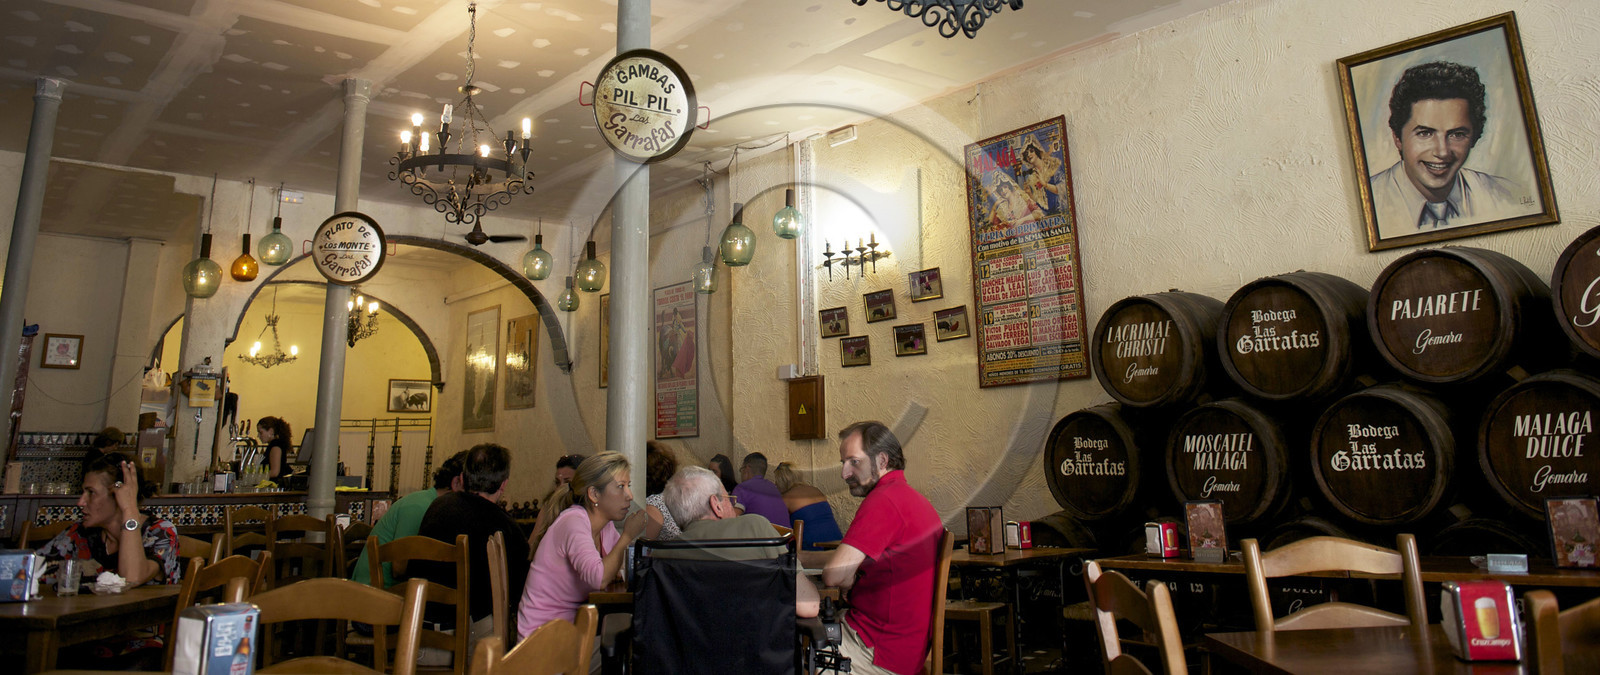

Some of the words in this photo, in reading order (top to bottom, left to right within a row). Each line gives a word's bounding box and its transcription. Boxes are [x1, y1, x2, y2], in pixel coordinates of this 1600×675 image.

[616, 63, 676, 94] GAMBAS
[613, 87, 638, 106] PIL
[647, 93, 672, 112] PIL
[629, 113, 651, 124] Las
[603, 112, 676, 152] Garrafas
[324, 221, 355, 240] PLATO
[358, 225, 371, 239] DE
[980, 230, 1004, 243] FERIA
[1005, 227, 1016, 238] de
[1017, 215, 1067, 235] PRIMAVERA
[338, 241, 371, 251] MONTE
[977, 243, 989, 252] Con
[989, 239, 1009, 250] motivo
[1010, 237, 1018, 246] de
[1018, 236, 1024, 244] la
[1024, 231, 1050, 242] SEMANA
[1050, 226, 1071, 236] SANTA
[978, 252, 986, 261] 4
[1003, 253, 1023, 262] CORRIDA
[1027, 257, 1036, 270] 13
[321, 253, 372, 277] Garrafas
[981, 264, 990, 279] 12
[1027, 270, 1041, 280] LUIS
[1044, 264, 1072, 277] DOMECQ
[981, 277, 1005, 289] SANCHEZ
[1041, 273, 1073, 285] CARTAGENA
[982, 285, 1005, 296] UCEDA
[1008, 281, 1025, 291] LEAL
[1029, 286, 1047, 296] DIEGO
[1048, 279, 1074, 292] VENTURA
[982, 293, 1001, 303] RAFAEL
[1001, 291, 1009, 300] DE
[1390, 288, 1484, 321] PAJARETE
[984, 312, 994, 325] 19
[1031, 305, 1041, 318] 20
[1051, 313, 1077, 325] ORTEGA
[1250, 309, 1297, 325] Bodega
[1003, 320, 1029, 331] PUERTO
[1039, 322, 1078, 334] MANZANARES
[1107, 320, 1173, 344] LACRIMAE
[1252, 325, 1277, 339] Las
[986, 339, 1012, 350] SALVADOR
[1012, 336, 1030, 346] VEGA
[1003, 330, 1029, 340] FERRERA
[1049, 331, 1079, 342] ESCRIBANO
[1236, 329, 1320, 355] Garrafas
[1412, 328, 1463, 355] Gomara
[986, 350, 1007, 362] ABONOS
[1007, 349, 1017, 360] 20%
[1017, 348, 1040, 358] DESCUENTO
[1116, 337, 1166, 359] CHRISTI
[1060, 362, 1082, 371] GRATIS
[1122, 362, 1159, 385] Gomara
[1513, 410, 1593, 437] MALAGA
[1346, 423, 1400, 441] Bodega
[1073, 436, 1109, 451] Bodega
[1183, 432, 1253, 453] MOSCATEL
[1348, 441, 1377, 455] Las
[1525, 433, 1587, 459] DULCE
[1074, 450, 1093, 463] Las
[1193, 451, 1248, 471] MALAGA
[1330, 448, 1426, 472] Garrafas
[1060, 458, 1126, 476] Garrafas
[1530, 464, 1589, 493] Gomara
[1200, 475, 1241, 499] Gomara
